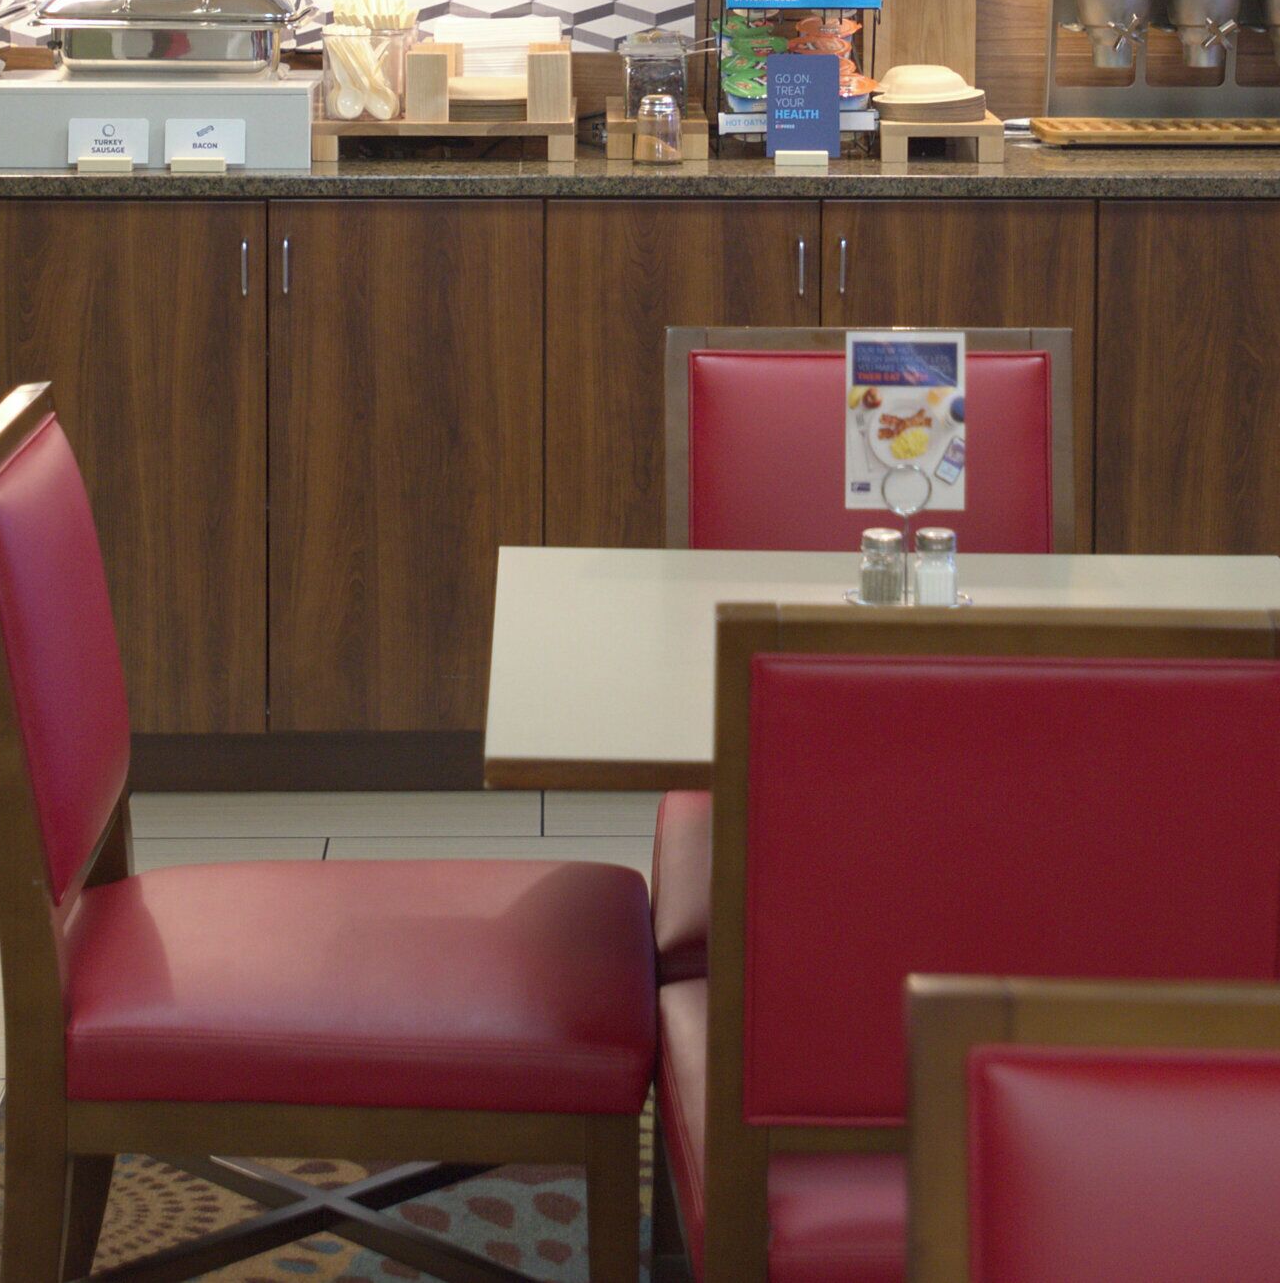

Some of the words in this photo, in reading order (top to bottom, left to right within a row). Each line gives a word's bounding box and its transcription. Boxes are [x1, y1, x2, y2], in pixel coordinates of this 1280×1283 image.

[775, 74, 791, 84] GO
[775, 86, 806, 96] TREAT
[775, 98, 805, 107] YOUR
[775, 109, 819, 119] HEALTH
[726, 119, 741, 127] HOT
[744, 118, 767, 127] OATM
[91, 146, 126, 154] SAUSAGE
[192, 142, 218, 150] BACON
